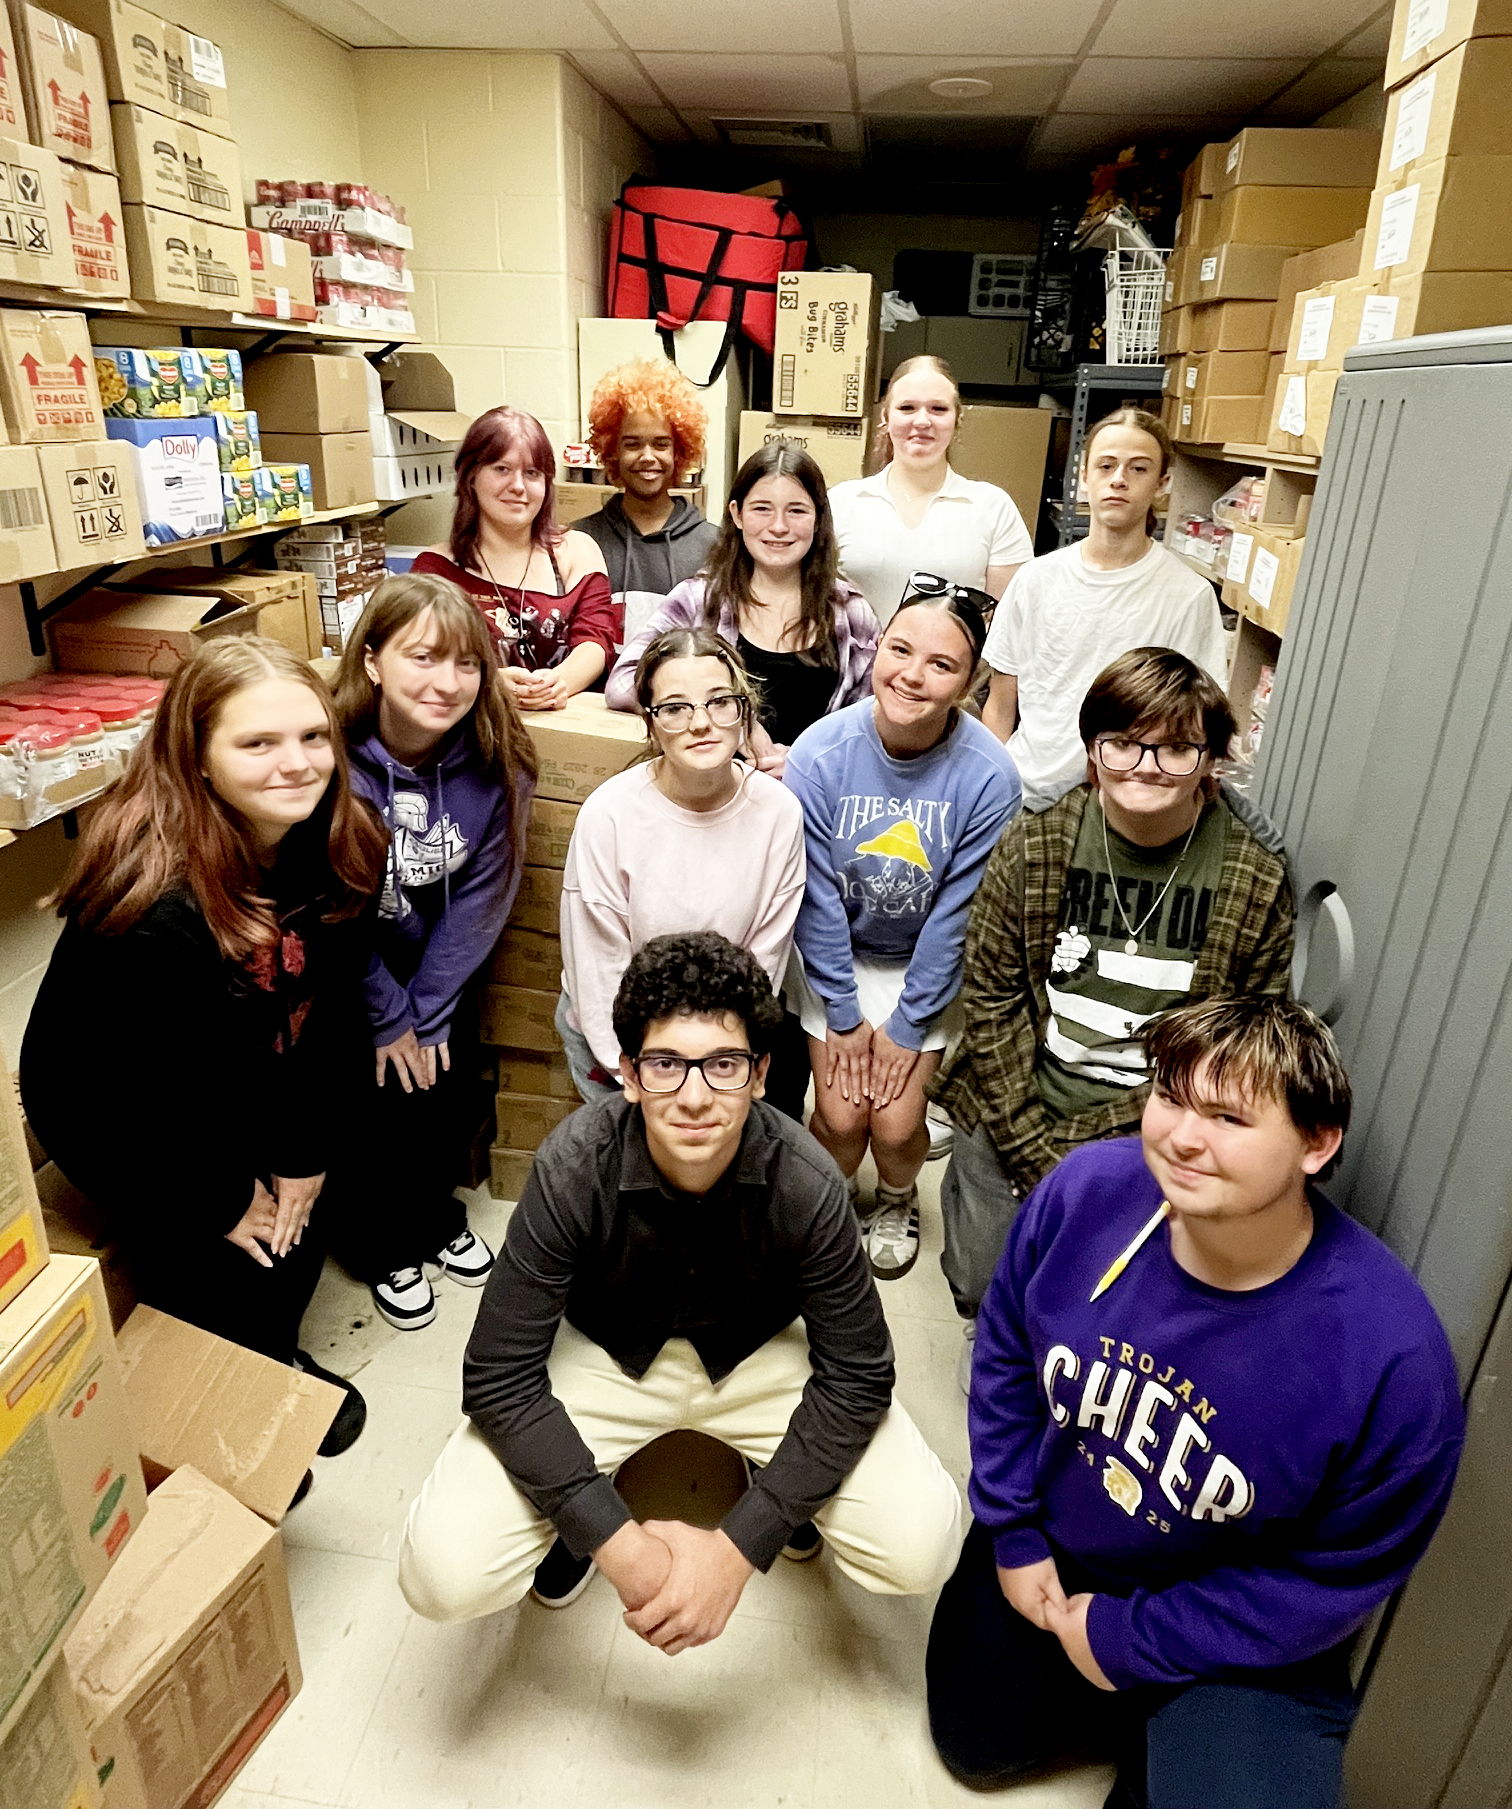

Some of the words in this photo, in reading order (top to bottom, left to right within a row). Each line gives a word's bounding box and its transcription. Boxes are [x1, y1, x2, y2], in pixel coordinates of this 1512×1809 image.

[780, 276, 799, 286] 3
[780, 293, 797, 309] FS
[807, 301, 819, 322] Bug
[828, 301, 849, 353] grahams
[806, 326, 819, 353] Bites
[120, 351, 129, 364] 8
[36, 393, 87, 405] FRAGILE
[846, 374, 859, 411] 55644
[164, 438, 196, 460] Dolly
[835, 795, 885, 840] THE
[887, 796, 951, 850] SALTY
[1100, 1336, 1218, 1424] TROJAN
[1043, 1345, 1255, 1523] CHEER
[1146, 1510, 1171, 1534] 25
